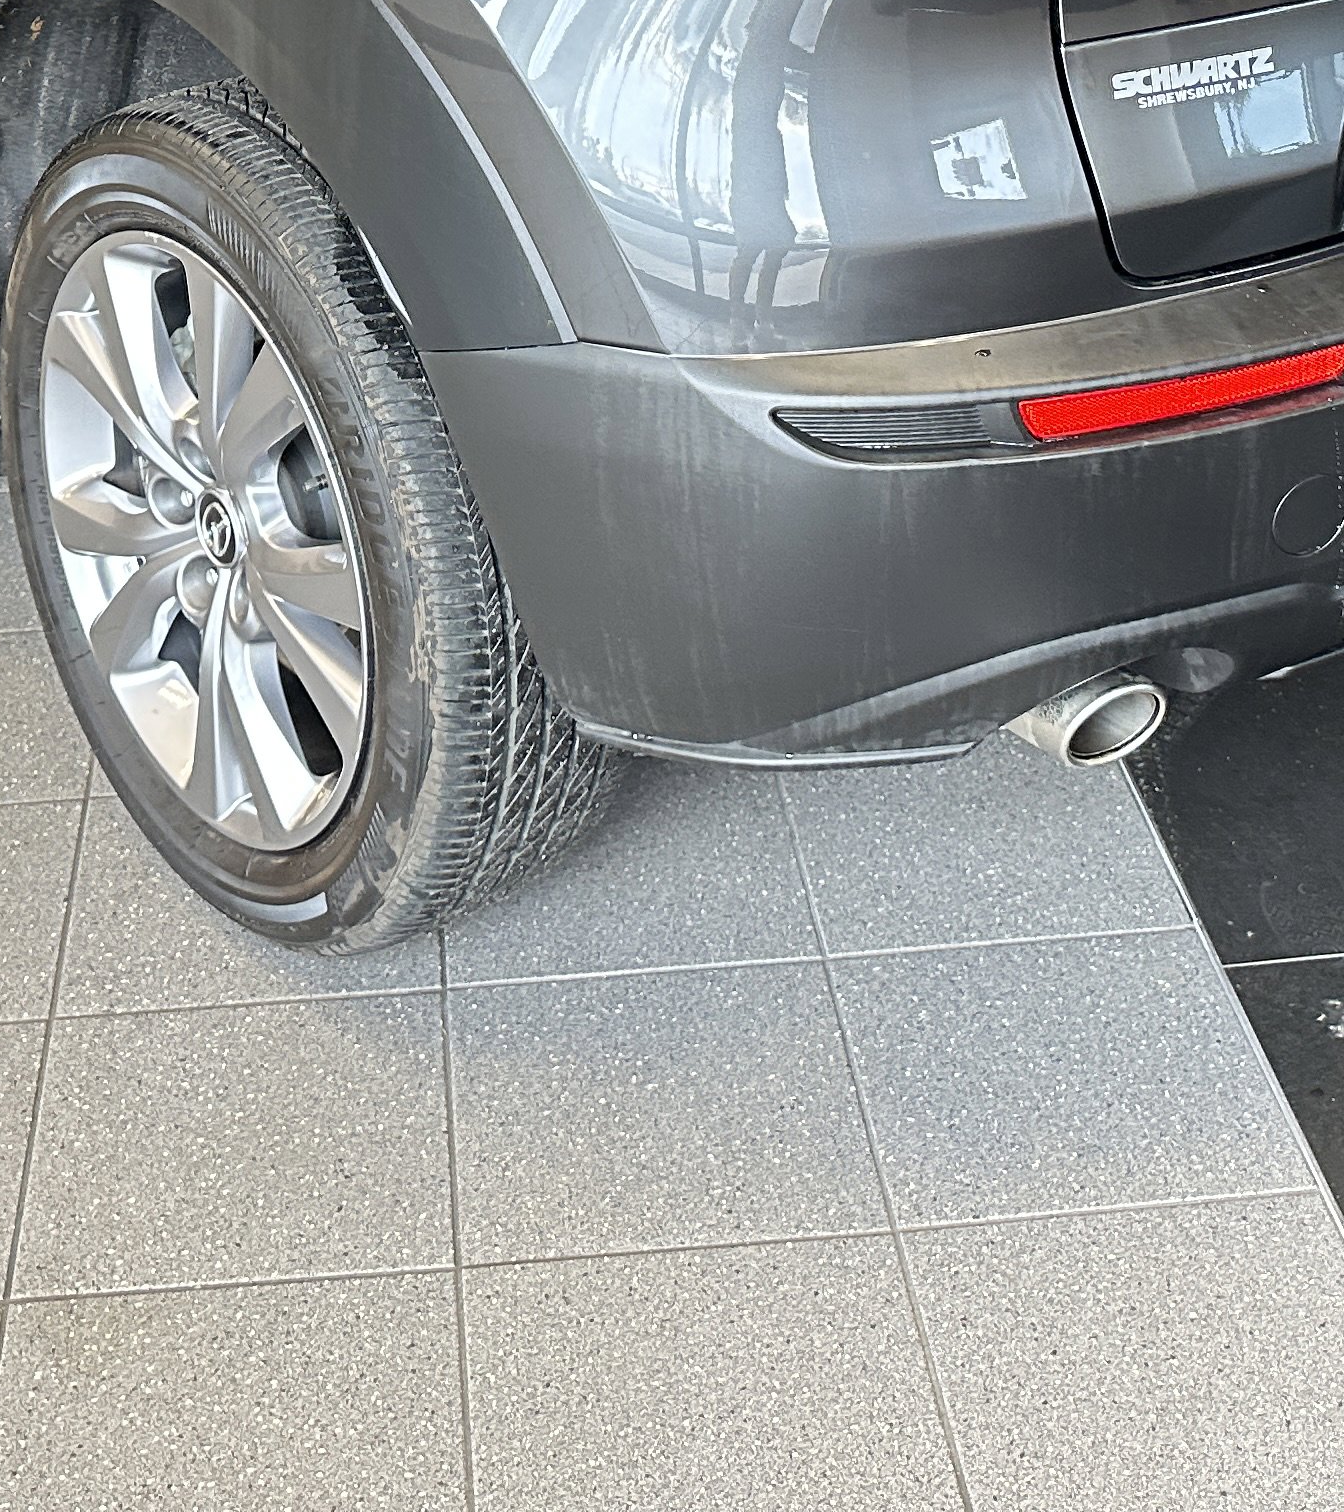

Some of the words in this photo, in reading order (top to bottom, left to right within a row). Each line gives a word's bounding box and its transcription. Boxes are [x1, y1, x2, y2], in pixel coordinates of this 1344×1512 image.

[1111, 46, 1275, 100] SCHWARTZ
[1137, 81, 1236, 109] SHREWSBURY,
[1238, 78, 1257, 91] NJ
